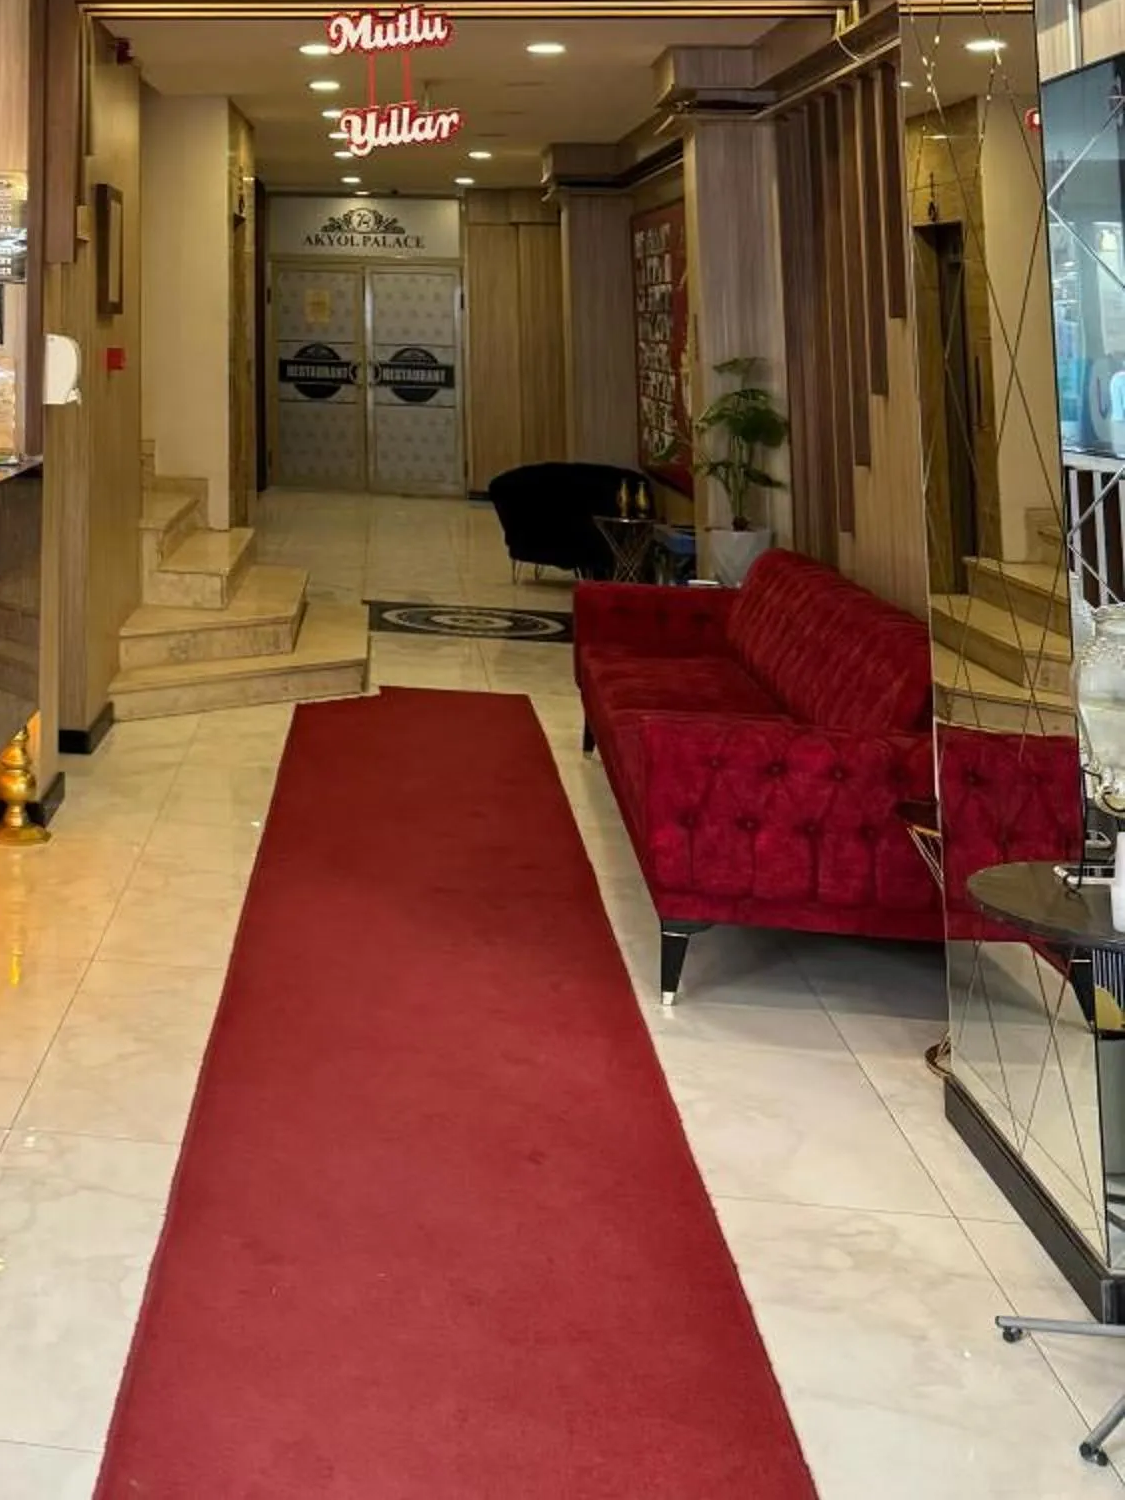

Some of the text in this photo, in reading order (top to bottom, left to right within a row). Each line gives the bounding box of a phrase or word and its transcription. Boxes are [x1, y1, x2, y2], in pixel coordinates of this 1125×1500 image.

[328, 6, 450, 56] Mutlu
[302, 235, 426, 249] AKYOL PALACE
